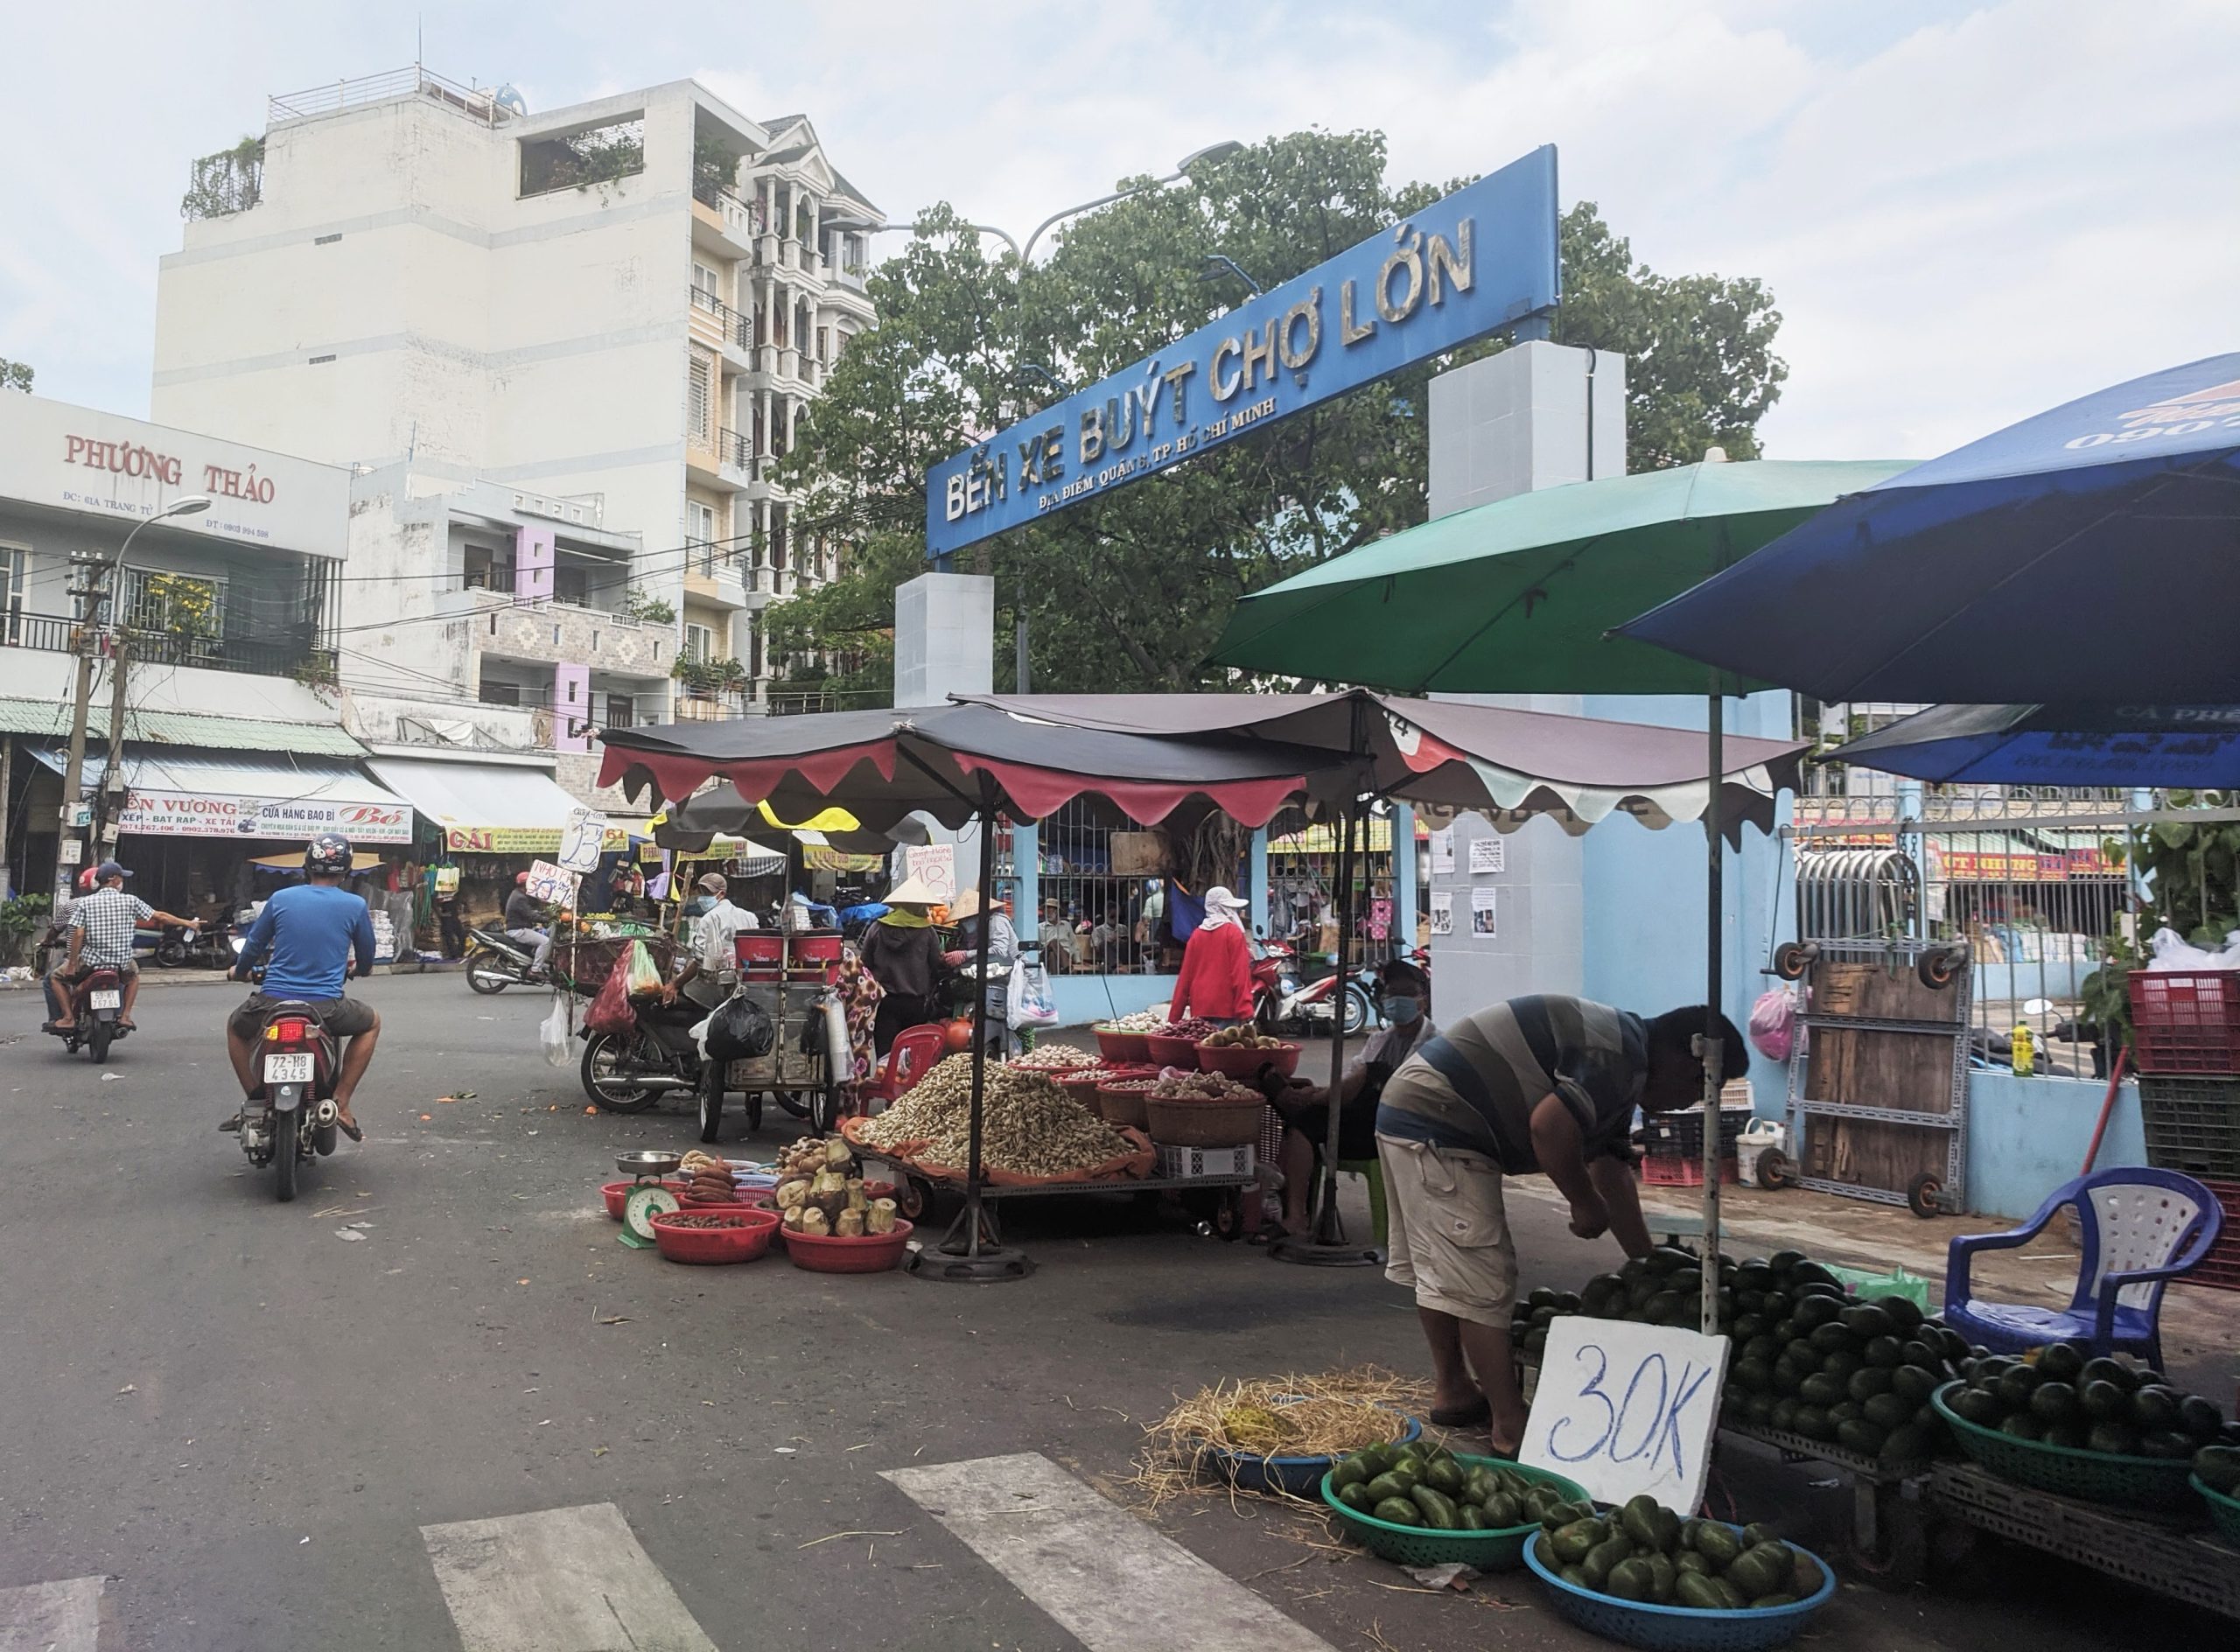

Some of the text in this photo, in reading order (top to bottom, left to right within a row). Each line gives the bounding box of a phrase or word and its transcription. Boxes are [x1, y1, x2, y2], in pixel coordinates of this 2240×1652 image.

[947, 218, 1475, 522] BẾN XE BUÝT CHỢ LỚN
[1231, 397, 1277, 430] MINH
[64, 434, 275, 505] PHƯƠNG THẢO
[104, 500, 136, 513] TRANG
[163, 798, 238, 816] VƯƠNG
[283, 807, 306, 820] HÀNG
[308, 809, 325, 821] BAO
[606, 828, 626, 840] 61
[272, 1055, 306, 1068] 72-H8
[271, 1068, 306, 1081] 4345
[1547, 1345, 1712, 1480] 30K
